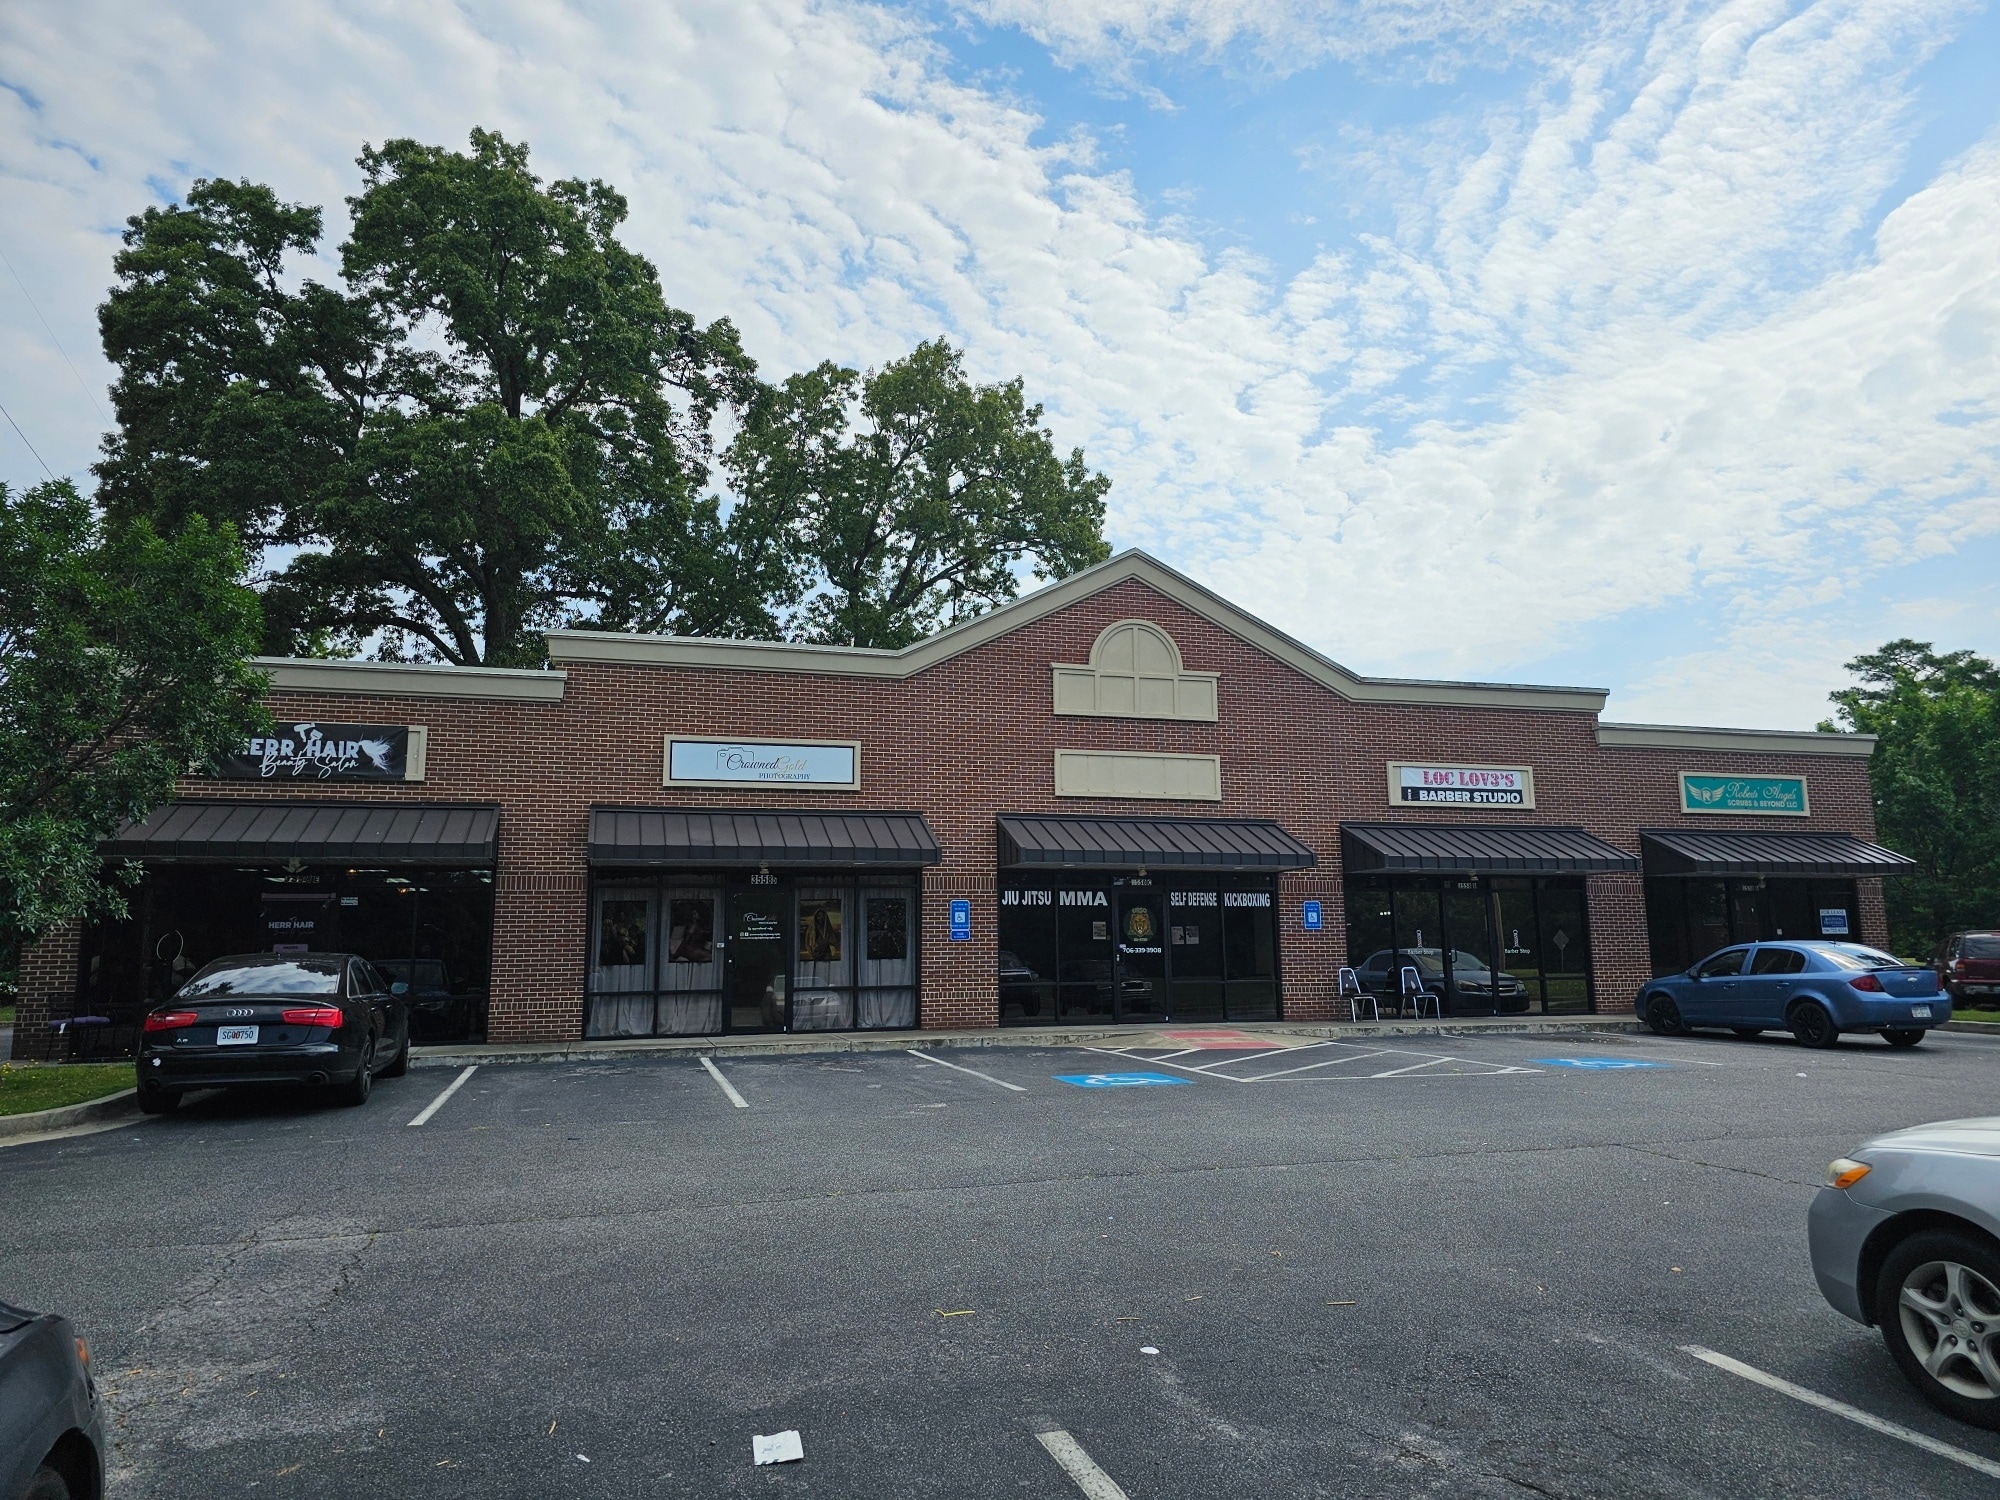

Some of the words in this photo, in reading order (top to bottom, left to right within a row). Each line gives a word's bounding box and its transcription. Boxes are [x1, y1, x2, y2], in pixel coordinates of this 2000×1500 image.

[242, 738, 295, 757] ERR
[306, 738, 359, 758] HAIR
[259, 752, 308, 777] Beauty
[313, 752, 359, 779] Salon
[759, 772, 811, 780] PHOTOGRAPHY
[1423, 770, 1454, 786] LOC
[1458, 772, 1514, 788] LOV3'S
[1419, 790, 1471, 802] BARBER
[1473, 791, 1520, 803] STUDIO
[1727, 799, 1752, 807] SCRUBS
[1001, 890, 1019, 906] JIU
[1022, 890, 1052, 906] JITSU
[1059, 891, 1108, 906] MMA
[1170, 891, 1187, 906] SELF
[1188, 892, 1218, 907] DEFENSE
[1224, 892, 1271, 907] KICKBOXING
[268, 921, 292, 929] HERR
